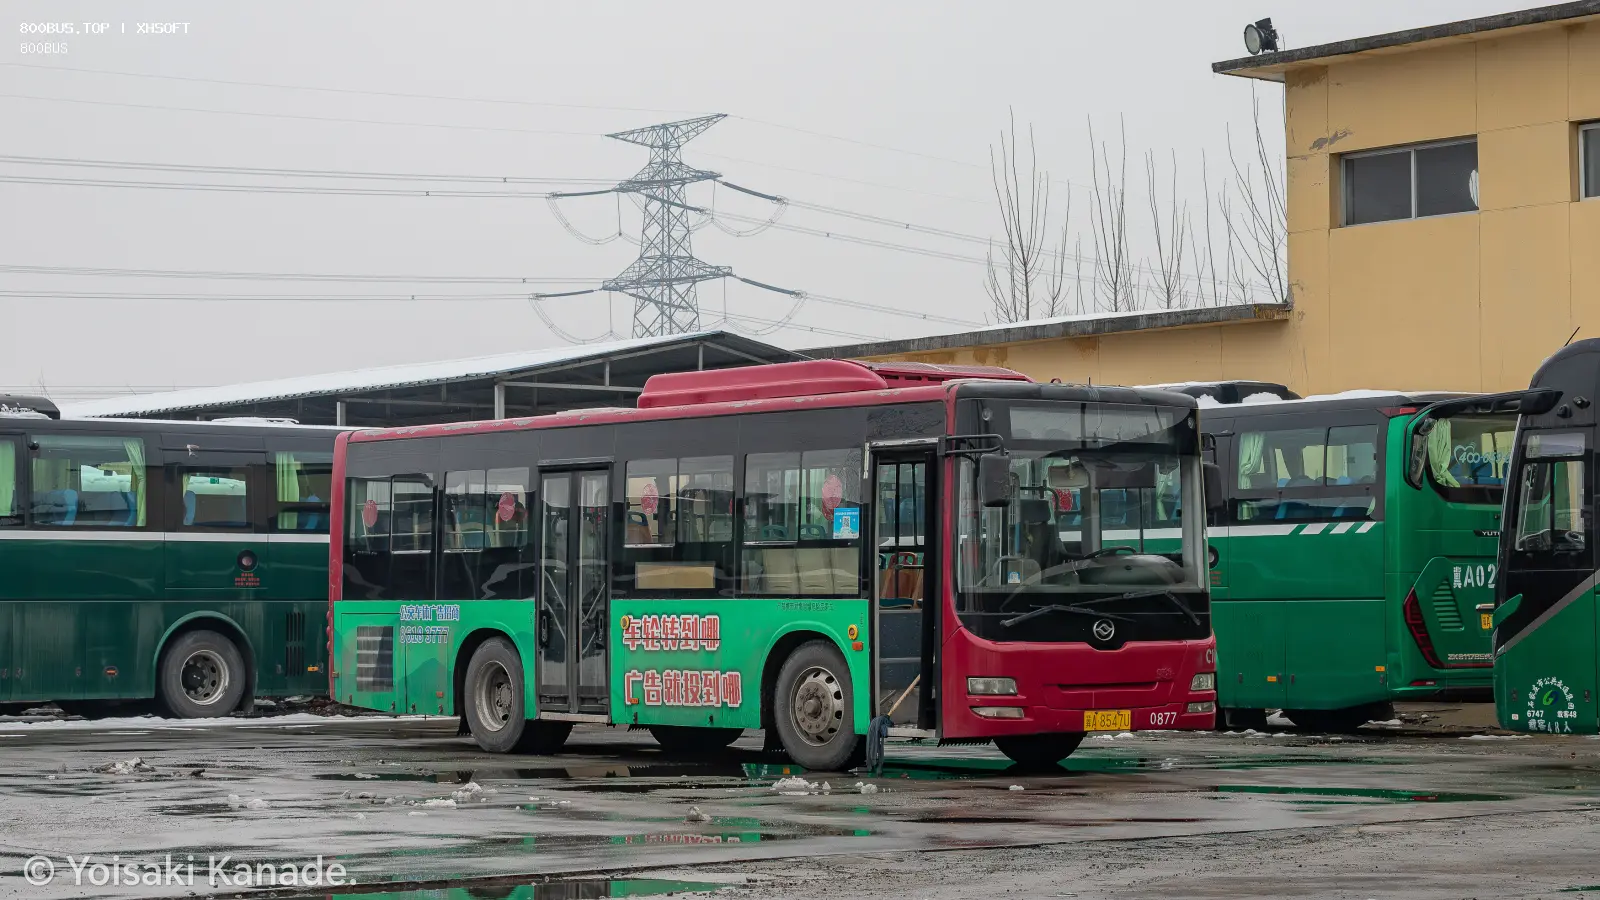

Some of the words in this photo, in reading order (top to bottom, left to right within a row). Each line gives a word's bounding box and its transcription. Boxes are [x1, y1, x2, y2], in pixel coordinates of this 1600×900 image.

[623, 615, 720, 651] 车轮转到哪
[625, 670, 742, 707] 广告就投到哪
[1149, 711, 1178, 726] 0877
[1526, 709, 1545, 718] 6747
